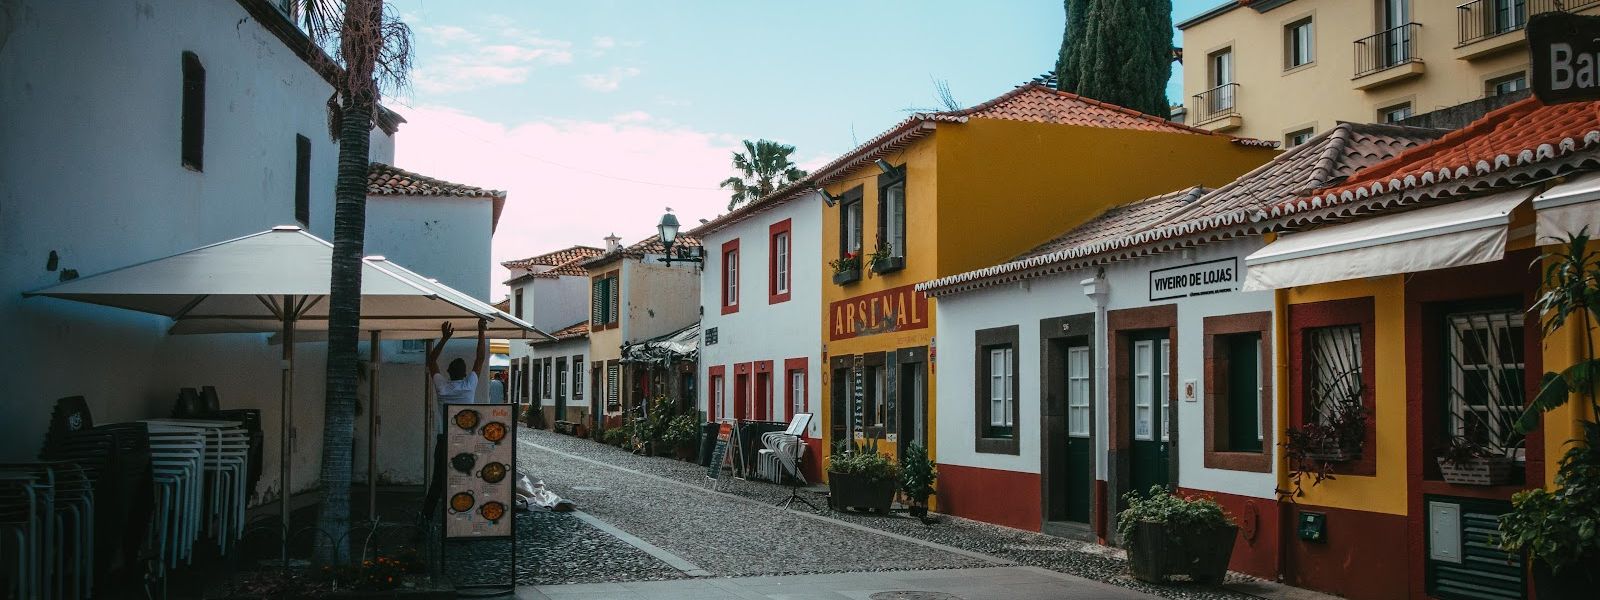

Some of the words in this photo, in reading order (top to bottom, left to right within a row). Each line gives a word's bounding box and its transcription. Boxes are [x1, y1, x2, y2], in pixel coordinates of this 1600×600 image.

[1551, 42, 1600, 90] Ba
[1155, 274, 1188, 291] VIVEIRO
[1190, 272, 1202, 286] DE
[1203, 268, 1232, 285] LOJAS
[835, 289, 921, 336] ARSENAL
